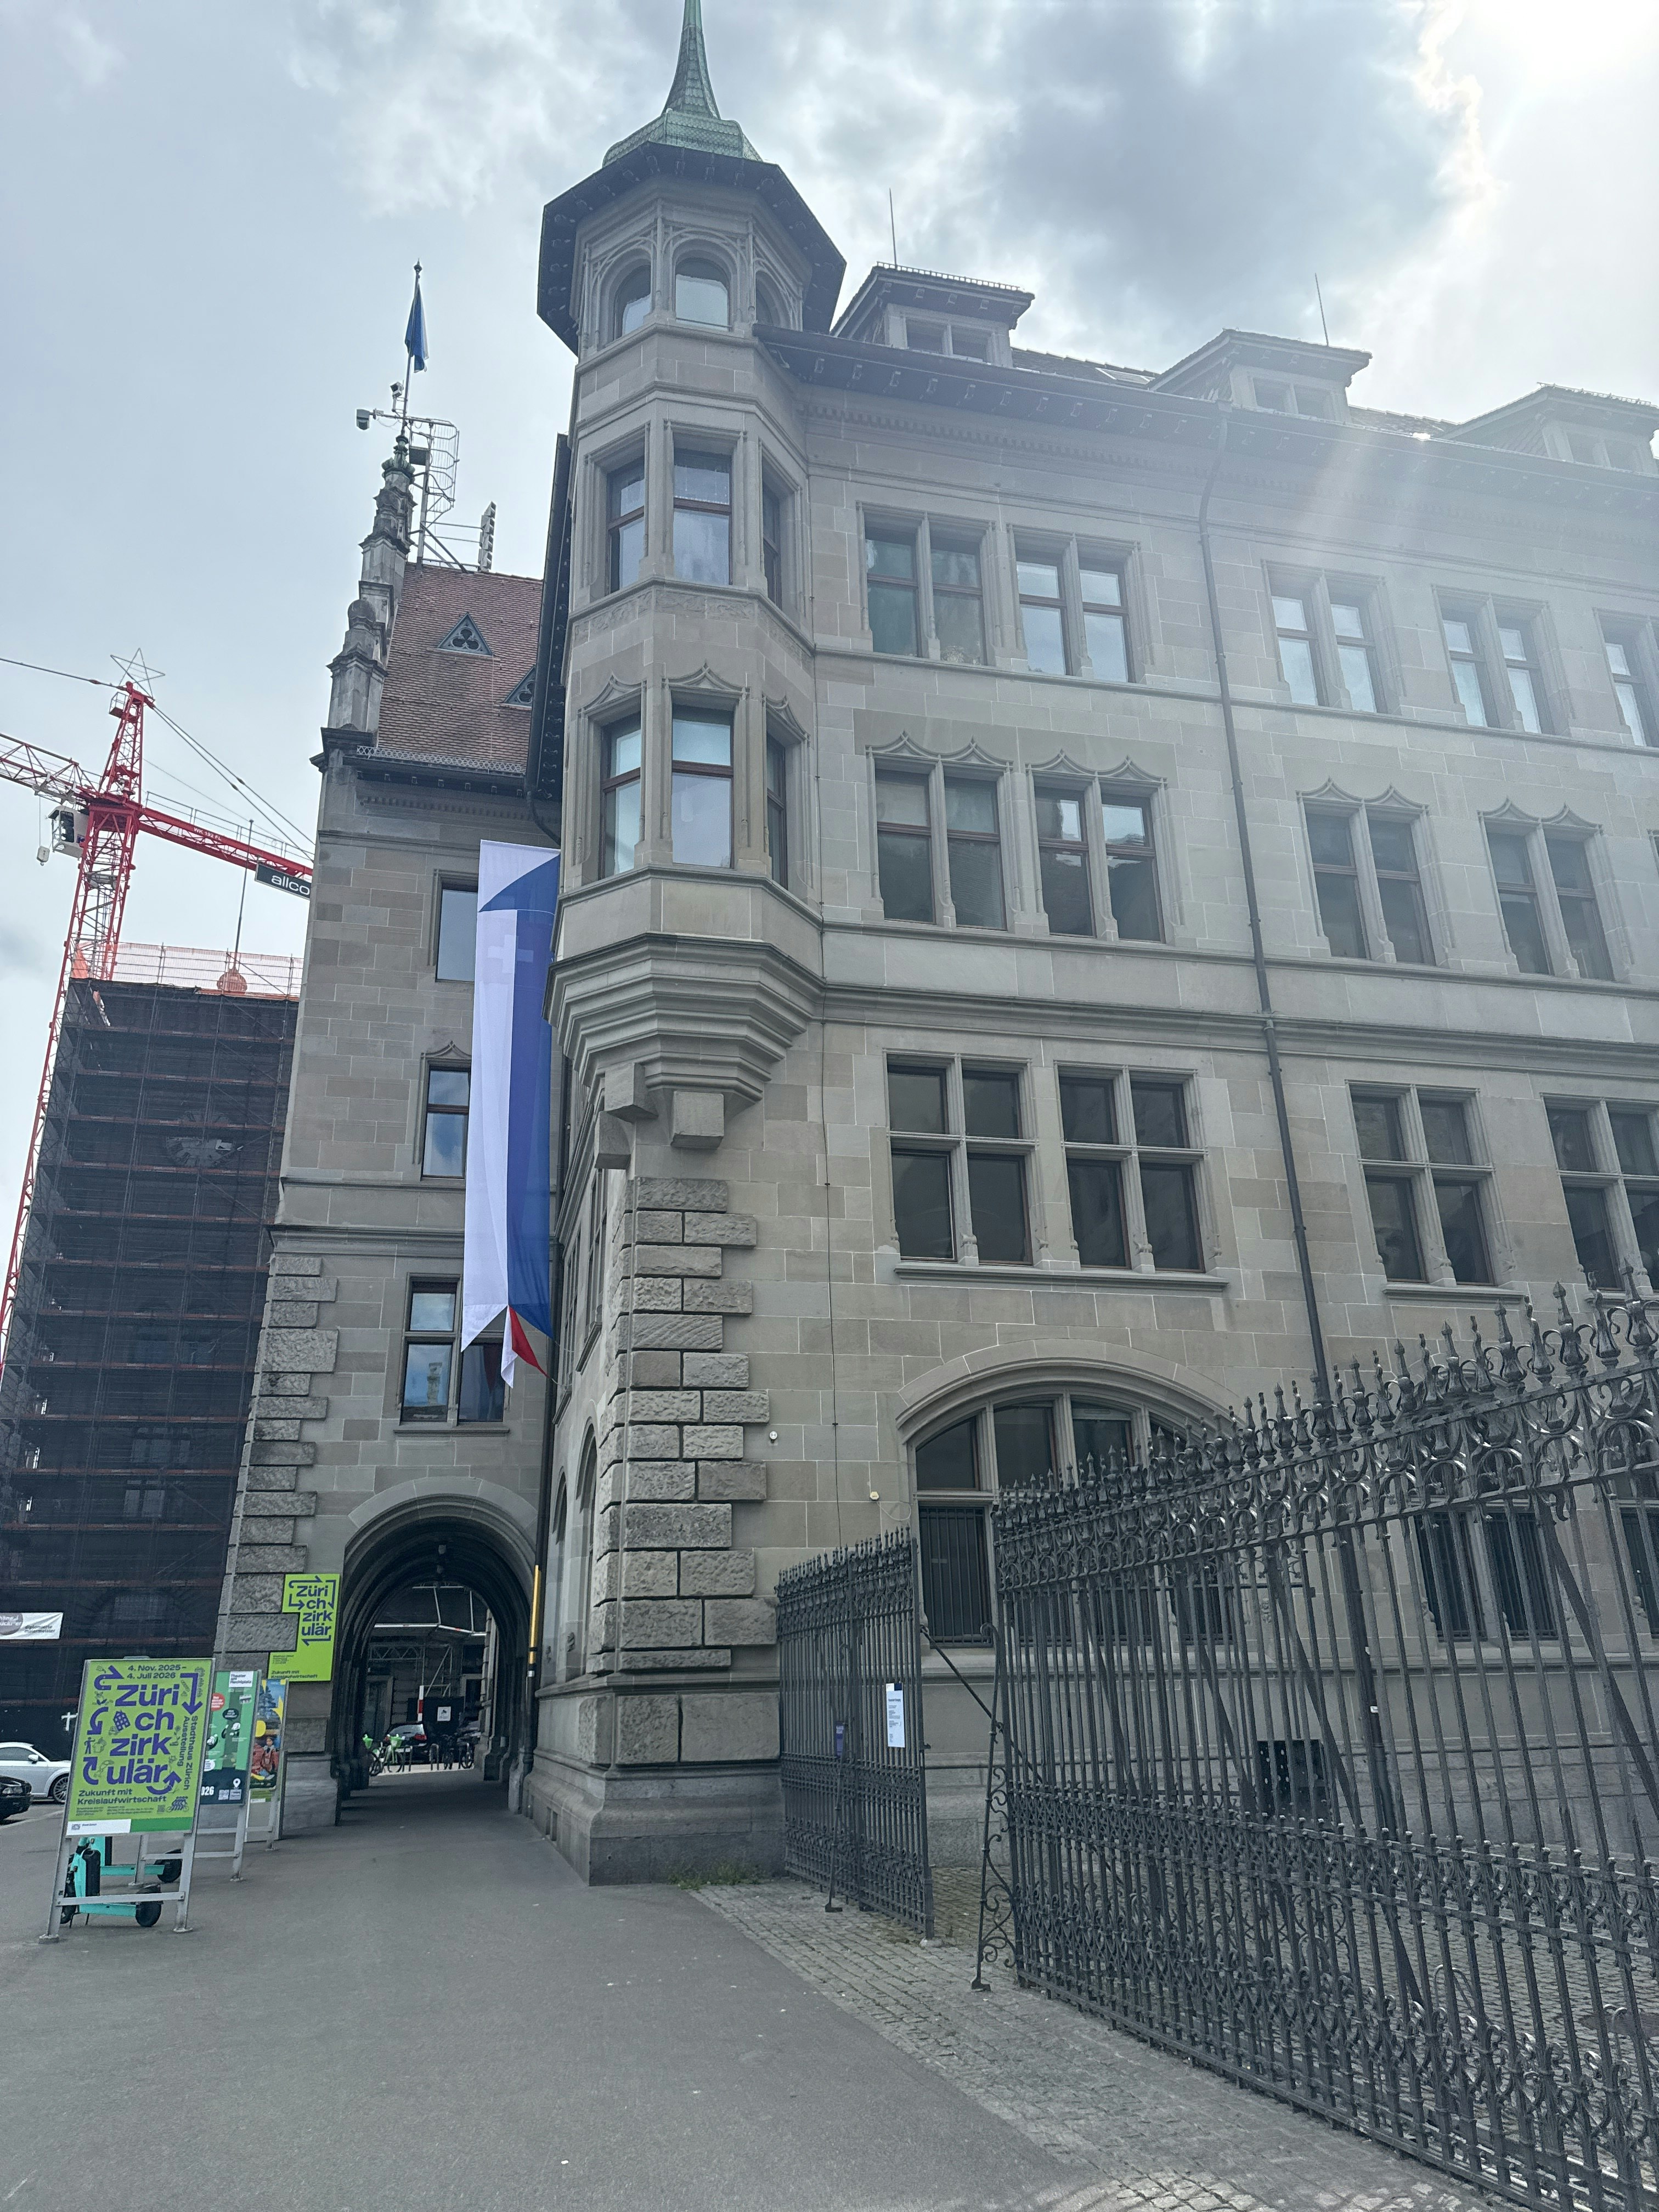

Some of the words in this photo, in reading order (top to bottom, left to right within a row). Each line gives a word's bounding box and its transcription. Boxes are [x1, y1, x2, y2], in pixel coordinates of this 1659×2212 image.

[271, 875, 310, 895] allco
[296, 1585, 329, 1597] Züri
[306, 1598, 326, 1609] ch
[302, 1610, 333, 1622] zirk
[301, 1622, 331, 1636] ulär
[115, 1684, 180, 1707] Züri
[135, 1708, 174, 1731] ch
[110, 1733, 173, 1756] zirk
[177, 1716, 190, 1767] Ausstellung
[187, 1716, 198, 1760] Stadthaus
[106, 1758, 168, 1785] ulär
[183, 1762, 193, 1790] Zürich
[77, 1796, 167, 1805] Kreislaufwirtschaft
